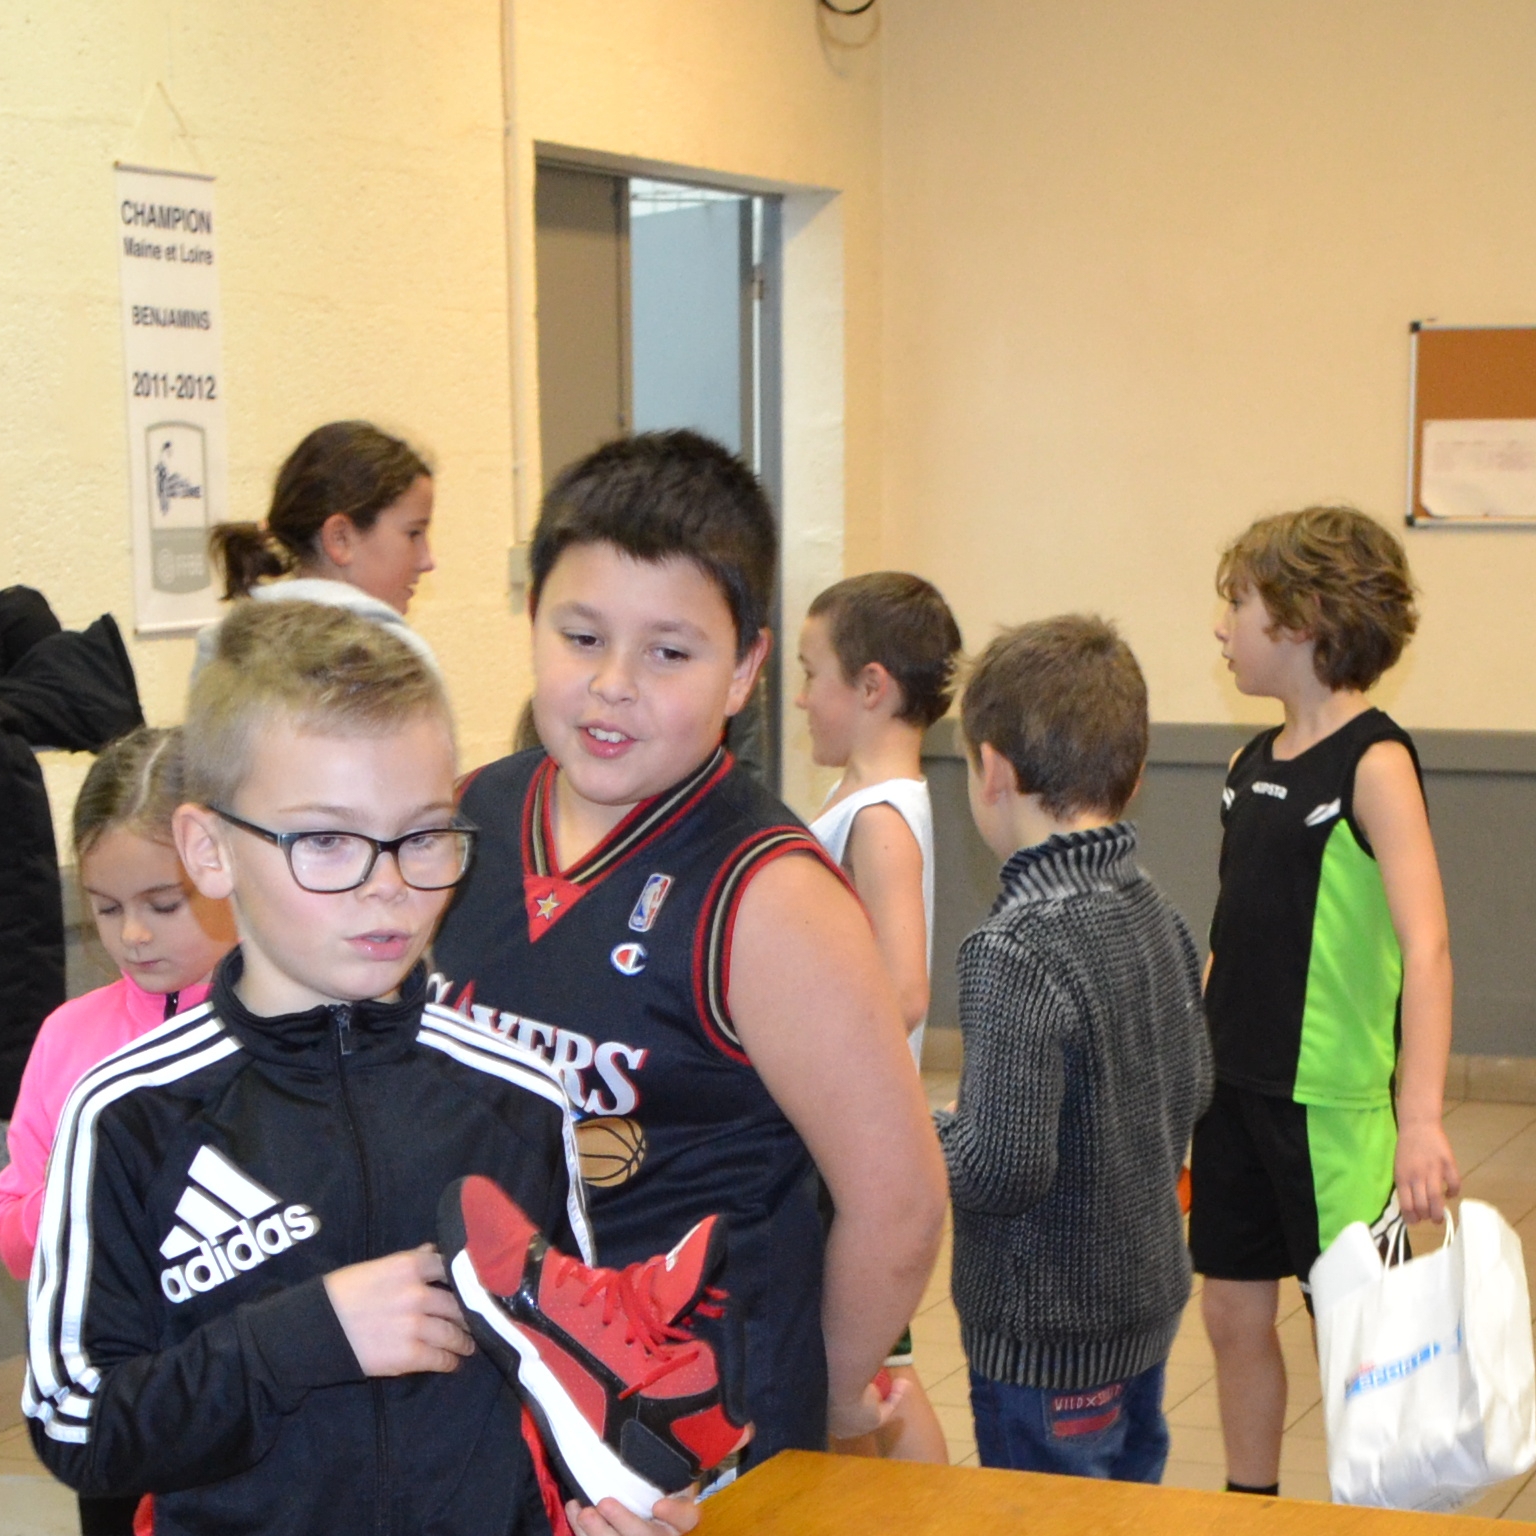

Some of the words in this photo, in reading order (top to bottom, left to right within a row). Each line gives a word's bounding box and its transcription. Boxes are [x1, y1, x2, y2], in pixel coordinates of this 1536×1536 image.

[121, 199, 212, 235] CHAMPION
[123, 237, 162, 262] Maine
[165, 244, 178, 263] et
[180, 242, 214, 267] Loire
[131, 304, 211, 331] BENJAMINS
[133, 371, 216, 400] 2011-2012
[161, 1204, 322, 1304] adidas
